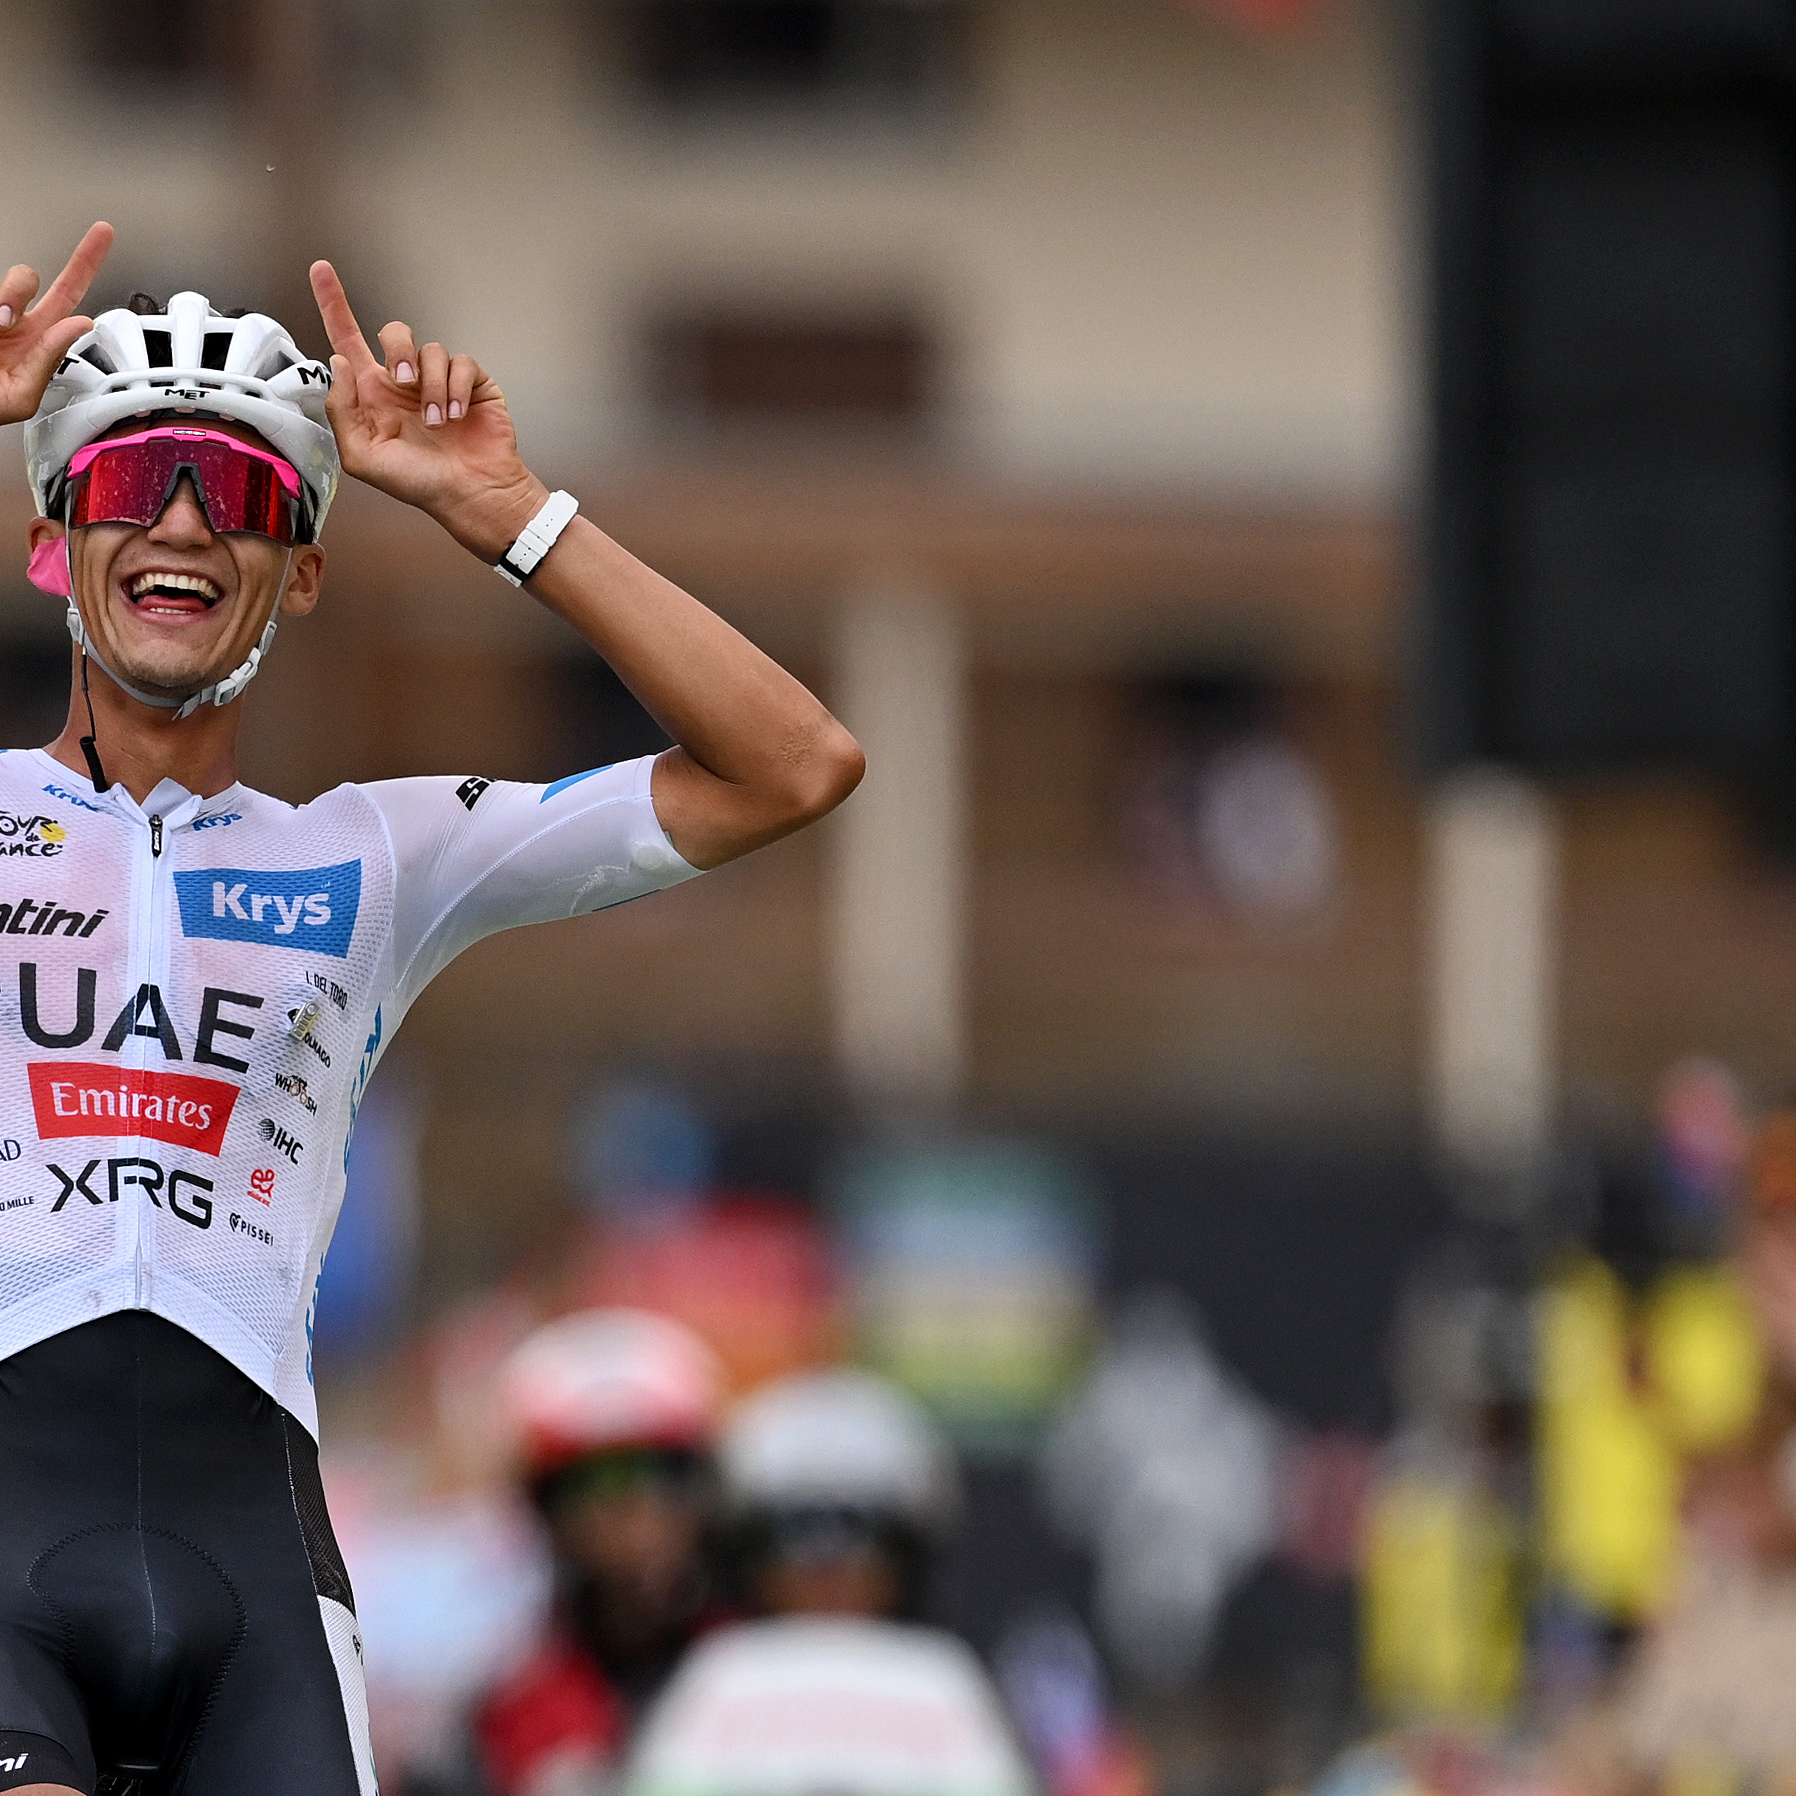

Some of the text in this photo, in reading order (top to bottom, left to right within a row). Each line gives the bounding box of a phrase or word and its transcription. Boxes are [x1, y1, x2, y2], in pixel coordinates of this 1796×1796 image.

[164, 388, 210, 401] MET
[191, 811, 244, 832] Krys
[212, 881, 332, 935] Krys
[313, 973, 328, 996] DEL
[329, 981, 348, 1011] TORO
[18, 961, 266, 1075] UAE
[303, 1031, 332, 1069] OLNAGO
[51, 1082, 214, 1132] Emirates
[273, 1127, 304, 1165] IHC
[6, 1195, 35, 1211] MILLE
[44, 1157, 215, 1231] XRG
[240, 1219, 275, 1247] PISSEI
